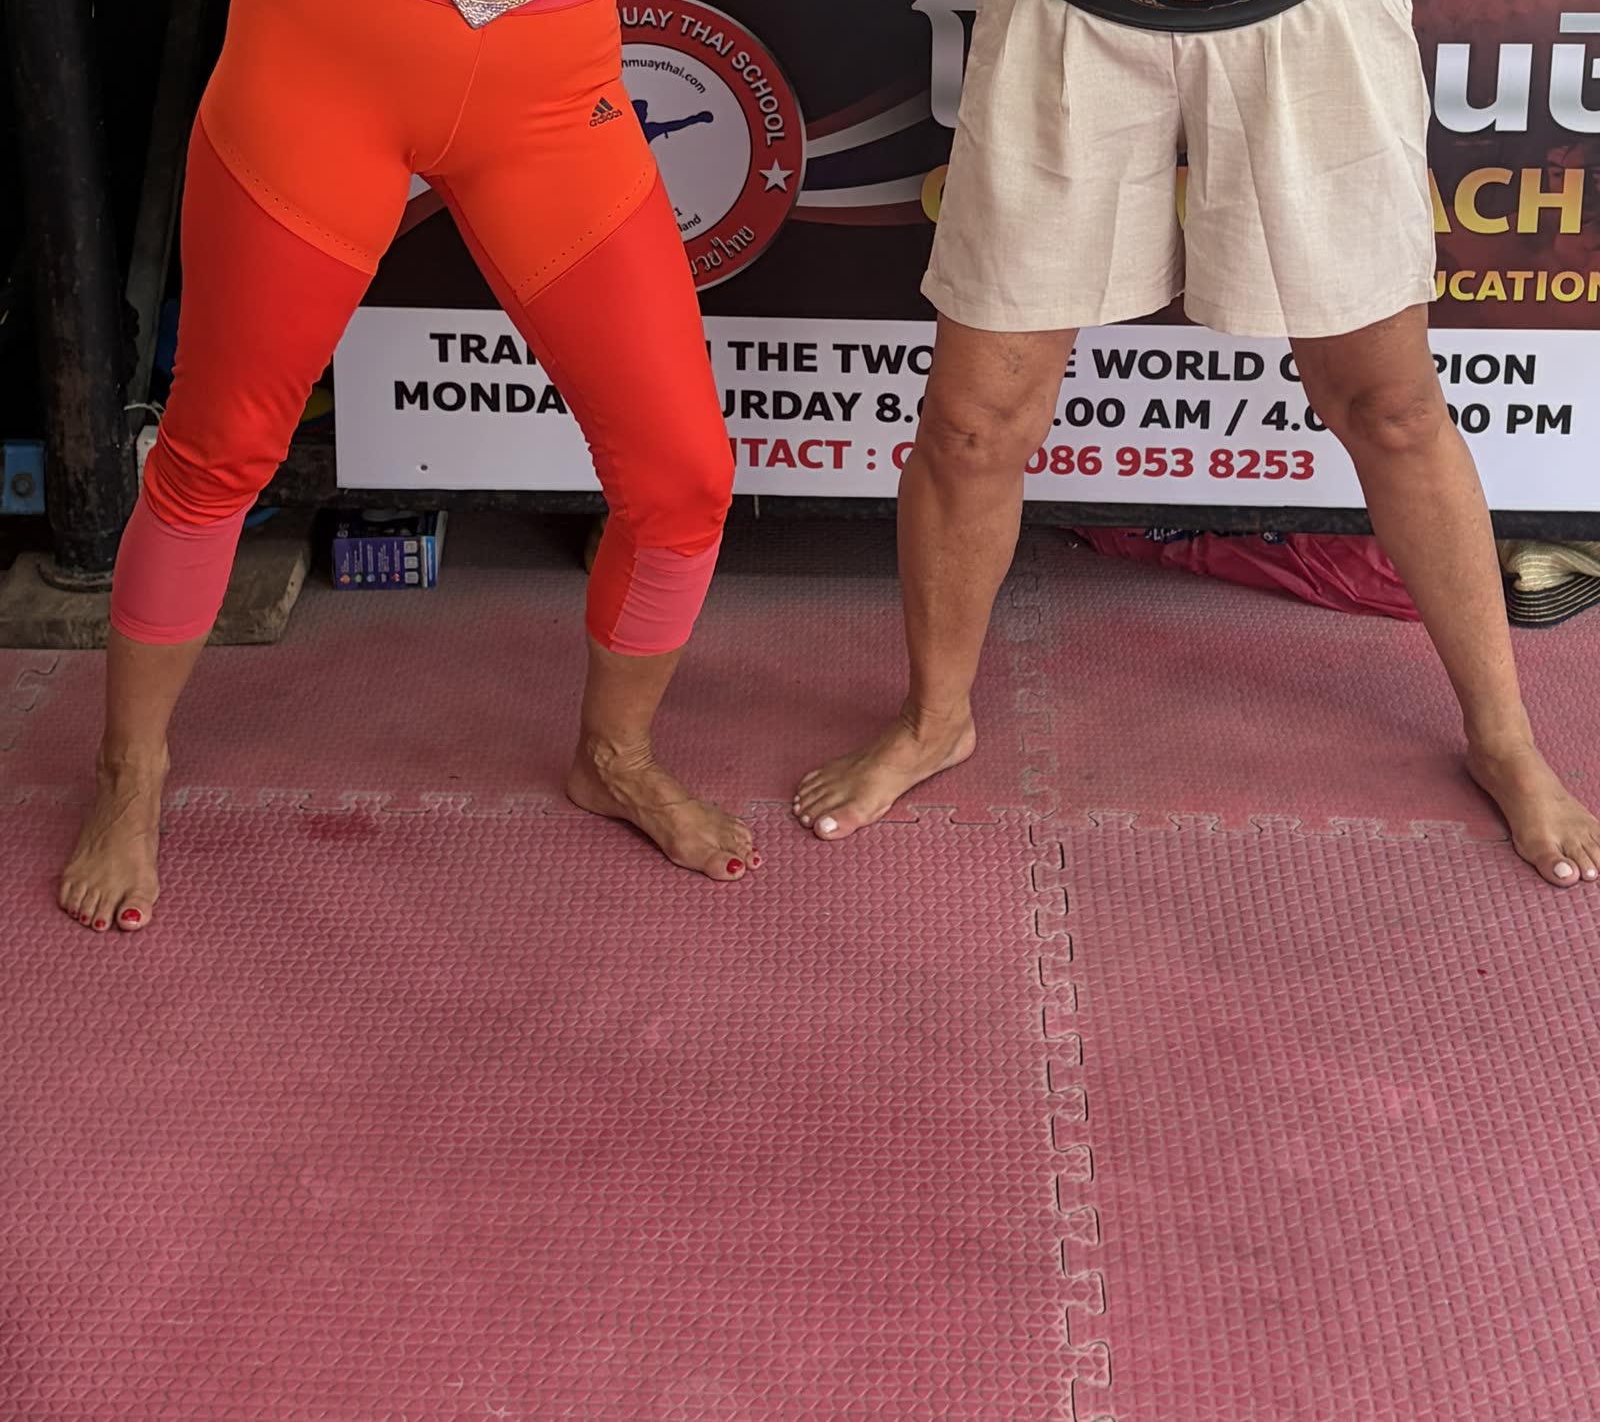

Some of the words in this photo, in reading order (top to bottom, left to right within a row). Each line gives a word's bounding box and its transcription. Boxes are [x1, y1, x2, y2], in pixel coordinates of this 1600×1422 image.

[617, 6, 673, 28] UAY
[680, 14, 735, 57] THAI
[731, 50, 785, 147] SCHOOL
[621, 58, 707, 95] nmuaythai.com
[589, 109, 623, 127] adidas
[677, 213, 702, 233] land
[429, 332, 538, 366] TRAI
[727, 341, 818, 373] THE
[832, 343, 934, 375] TWO
[1091, 348, 1265, 382] WORLD
[394, 380, 569, 415] MONDA
[722, 389, 862, 423] URDAY
[1053, 396, 1126, 429] .00
[1139, 398, 1211, 430] AM
[1224, 398, 1249, 437] /
[1261, 400, 1329, 432] 4.0
[1506, 403, 1573, 435] PM
[728, 437, 852, 470] TACT
[1024, 444, 1103, 476] 086
[1115, 446, 1195, 478] 953
[1207, 448, 1315, 481] 8253
